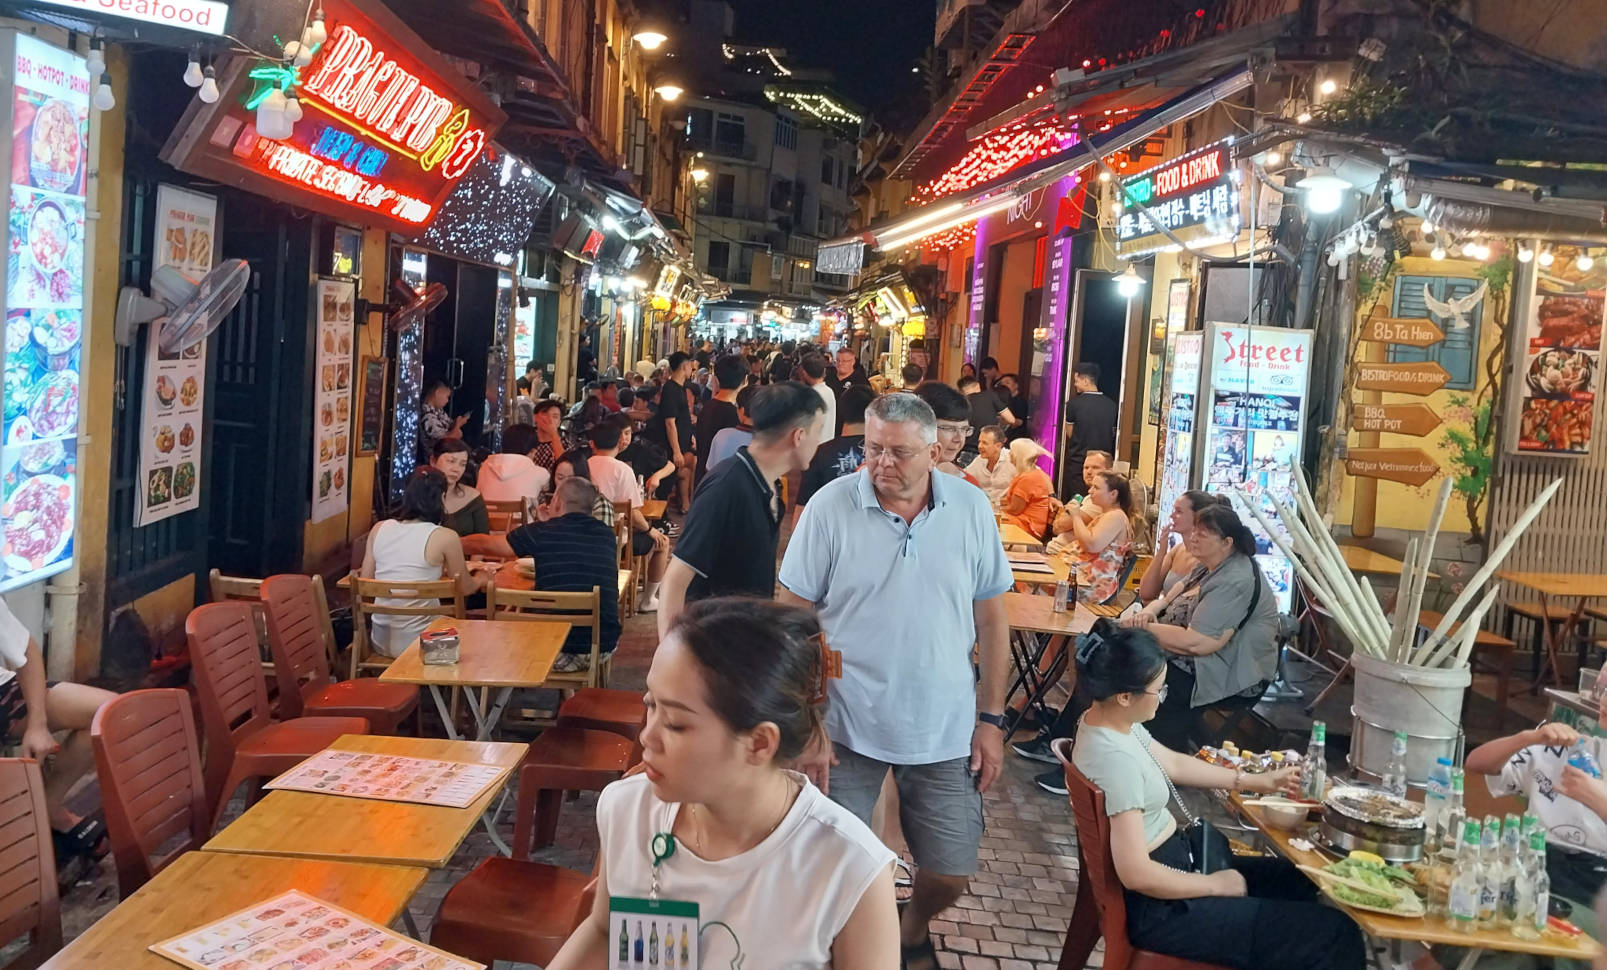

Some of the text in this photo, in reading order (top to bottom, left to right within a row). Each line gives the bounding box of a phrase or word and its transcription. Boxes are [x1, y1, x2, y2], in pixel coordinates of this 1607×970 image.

[16, 55, 31, 78] BBQ
[37, 63, 65, 86] HOTPOT
[1157, 166, 1180, 196] FOOD
[1181, 163, 1189, 188] &
[1189, 151, 1220, 185] DRINK
[1373, 321, 1393, 340] 8b
[1395, 324, 1409, 340] Ta
[1220, 330, 1304, 363] Street
[1268, 362, 1291, 371] Drink
[1364, 406, 1386, 419] BBQ
[1363, 419, 1402, 430] HOT POT
